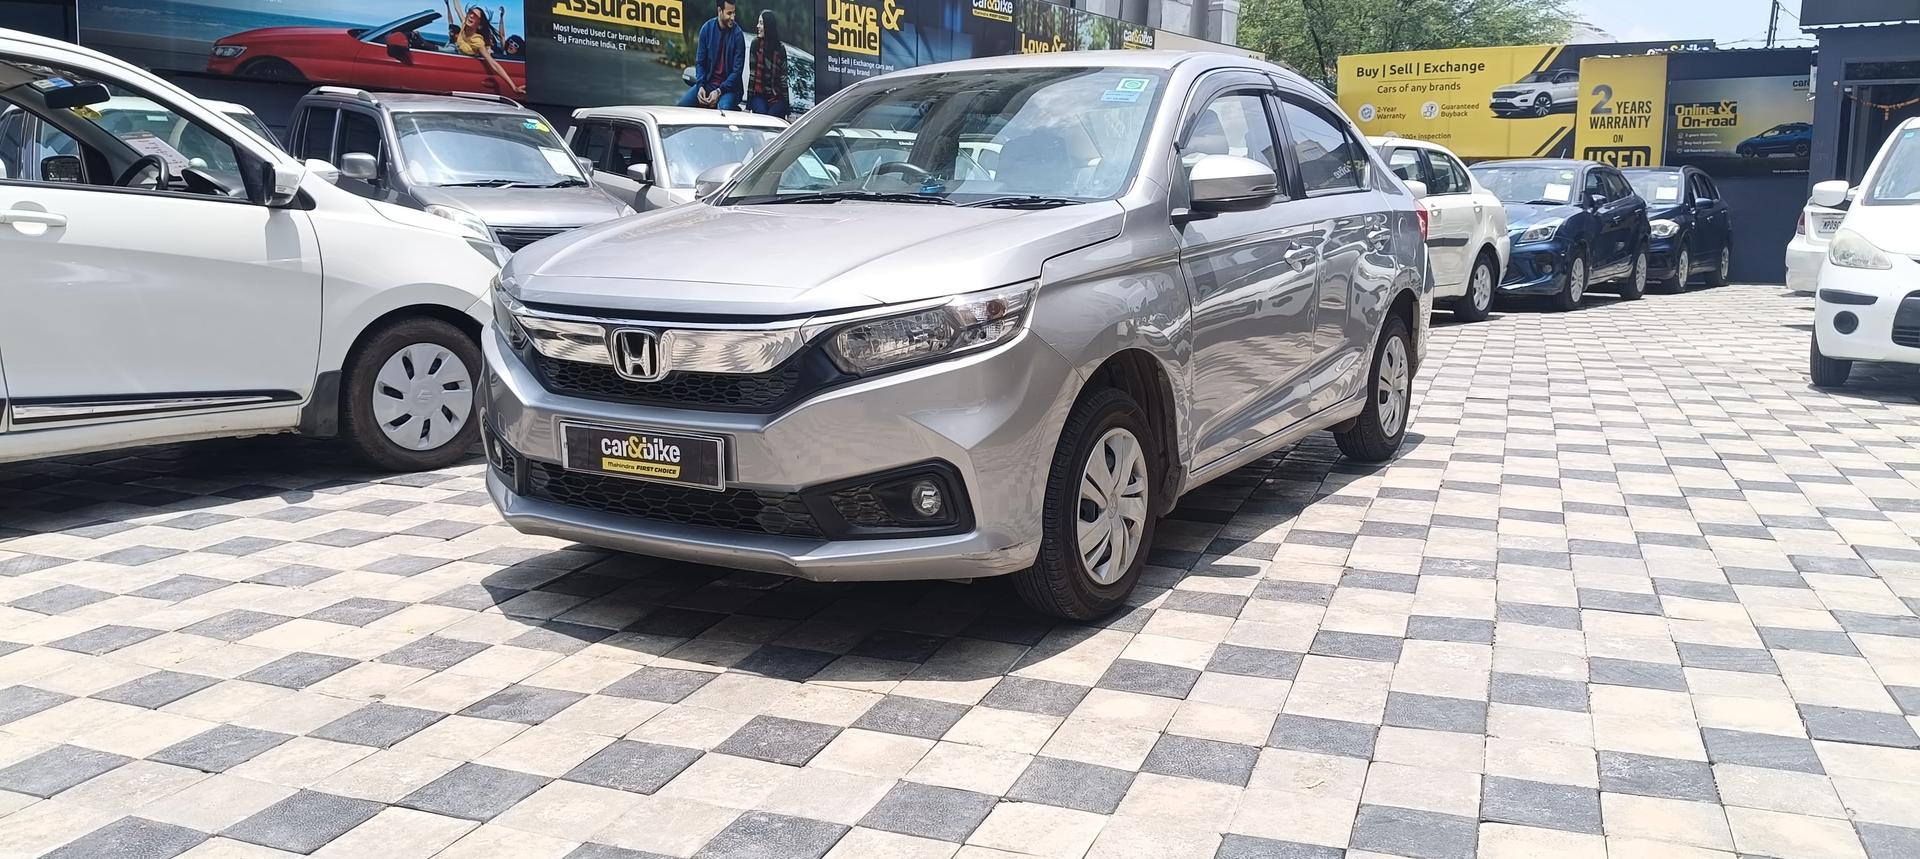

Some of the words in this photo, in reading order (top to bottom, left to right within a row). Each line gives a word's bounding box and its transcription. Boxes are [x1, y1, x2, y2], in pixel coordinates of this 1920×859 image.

[827, 0, 877, 24] Drive
[881, 0, 905, 31] &
[552, 23, 570, 32] Most
[570, 25, 589, 35] loved
[589, 28, 606, 38] Used
[607, 31, 618, 39] Car
[618, 33, 637, 42] brand
[644, 37, 660, 46] India
[827, 20, 878, 50] Smile
[557, 34, 567, 45] By
[568, 36, 600, 47] Franchise
[600, 40, 618, 50] India,
[618, 43, 627, 51] ET
[1021, 33, 1049, 53] Love
[1051, 34, 1067, 52] &
[827, 55, 838, 65] Buy
[841, 57, 850, 65] Sell
[853, 59, 875, 69] Exchange
[1356, 67, 1379, 78] Buy
[1389, 62, 1413, 75] Sell
[1423, 61, 1485, 74] Exchange
[827, 64, 841, 73] bikes
[847, 68, 856, 76] any
[856, 68, 870, 77] brand
[1377, 85, 1397, 94] Cars
[1398, 84, 1409, 92] of
[1410, 84, 1427, 94] any
[1429, 82, 1461, 92] brands
[1591, 84, 1613, 115] 2
[1616, 101, 1652, 114] YEARS
[1440, 110, 1468, 118] Buyback
[1674, 103, 1716, 116] Online
[1717, 100, 1738, 116] &
[1589, 116, 1651, 129] WARRANTY
[1682, 115, 1738, 127] On-road
[1417, 132, 1452, 140] inspection
[1613, 134, 1624, 143] ON
[601, 435, 681, 463] car&bike
[607, 461, 635, 470] Mahindra
[654, 467, 677, 475] CHOICE
